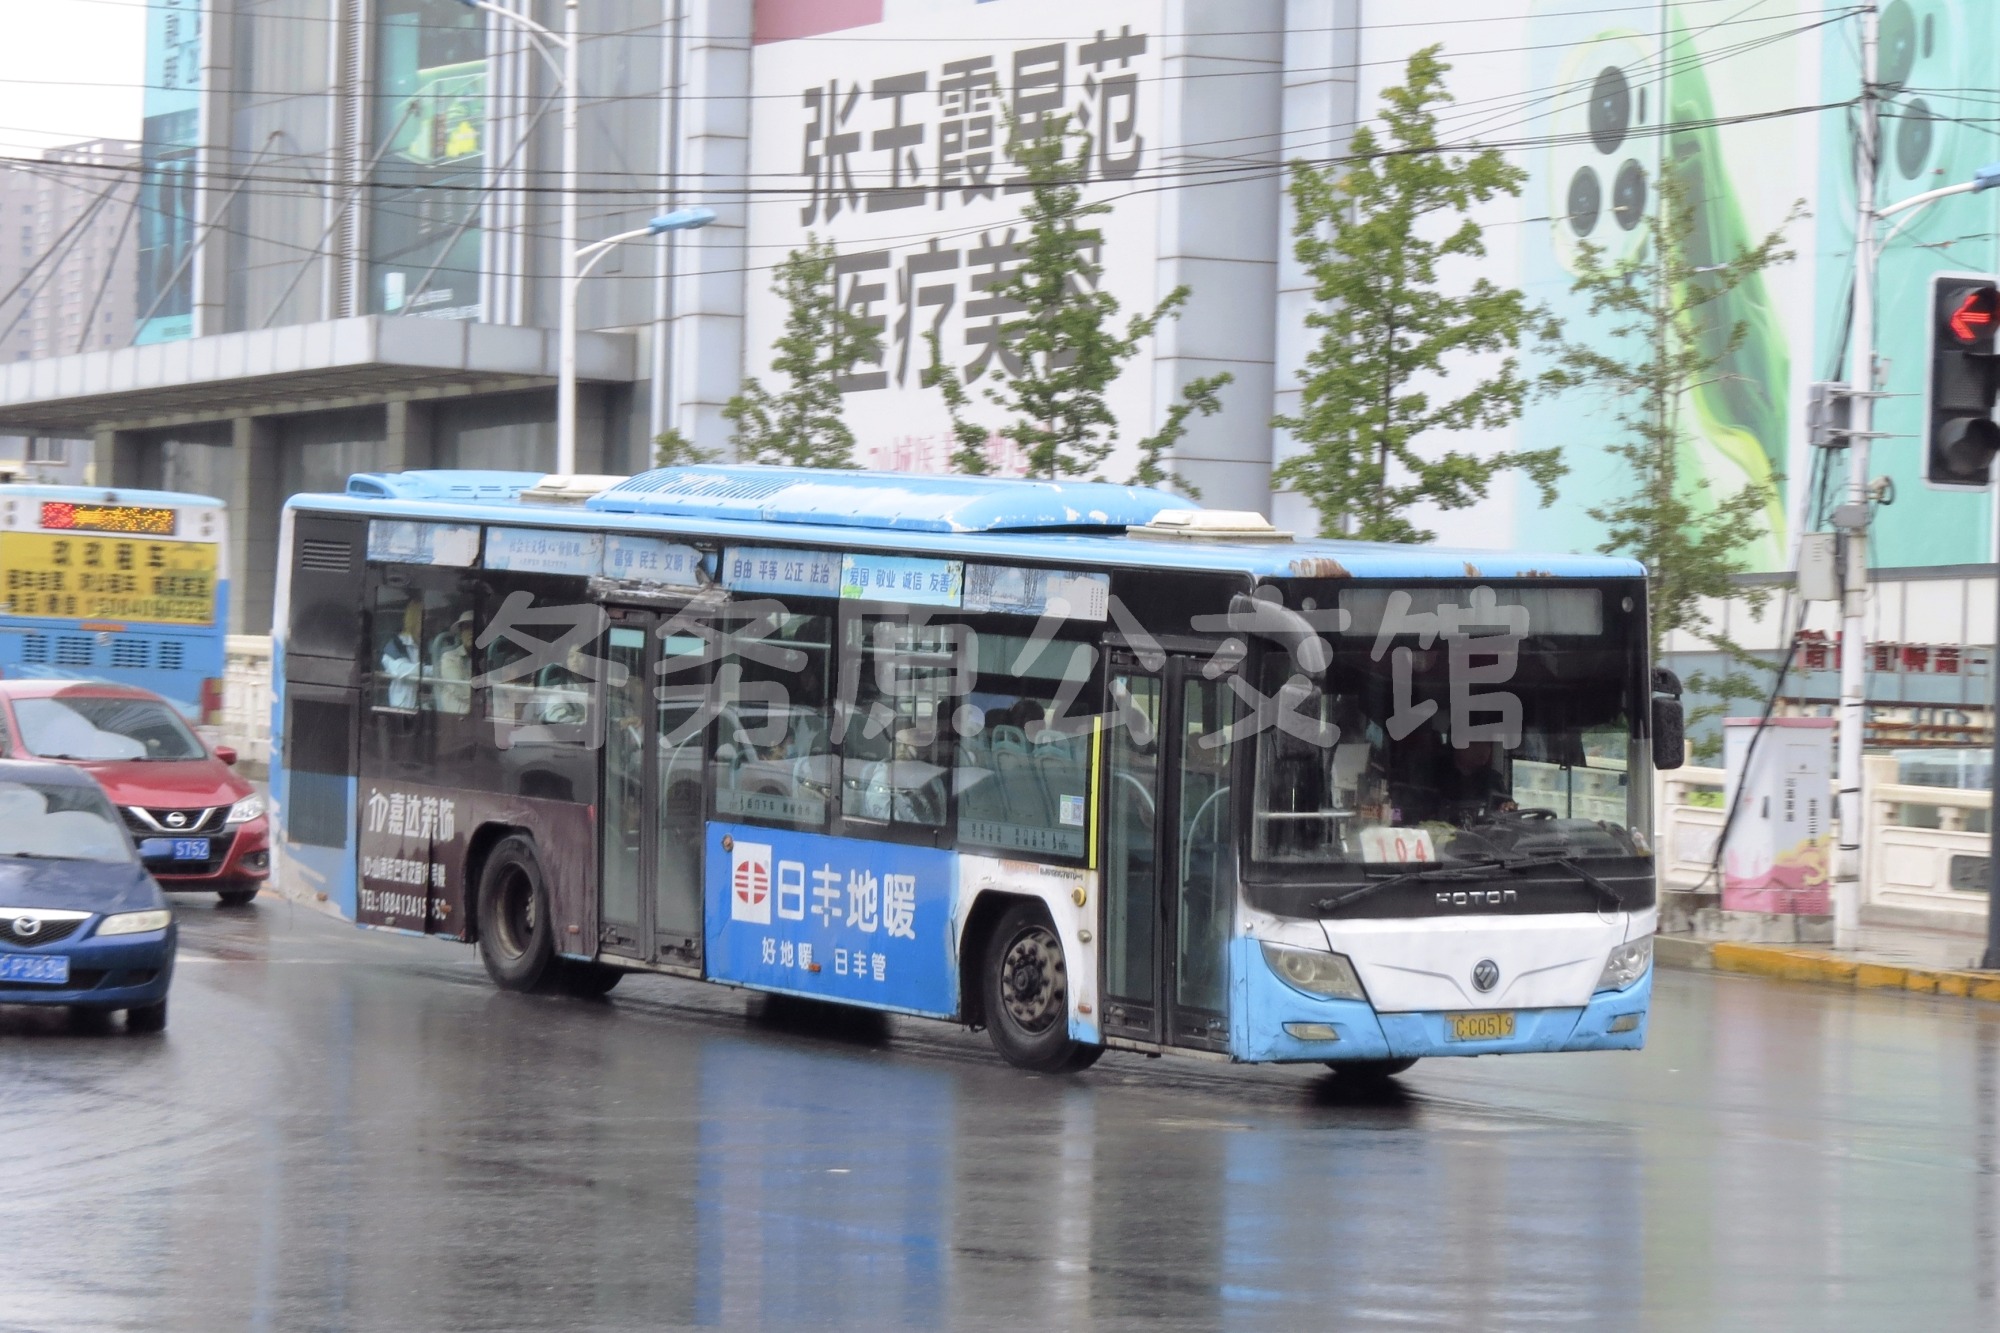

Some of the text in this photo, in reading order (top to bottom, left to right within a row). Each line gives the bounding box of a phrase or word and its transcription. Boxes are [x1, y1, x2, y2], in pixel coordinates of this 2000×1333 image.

[800, 24, 1147, 227] 张玉霞星范
[614, 549, 634, 568] 富强
[639, 551, 658, 570] 民主
[665, 553, 684, 572] 文明
[733, 559, 830, 584] 自由 平等 公正 法治
[850, 567, 951, 593] 爱国 敬业 诚信 友善
[777, 860, 917, 941] 日丰地暖
[1435, 889, 1517, 907] FOTON
[761, 937, 887, 982] 好地暖 日丰管
